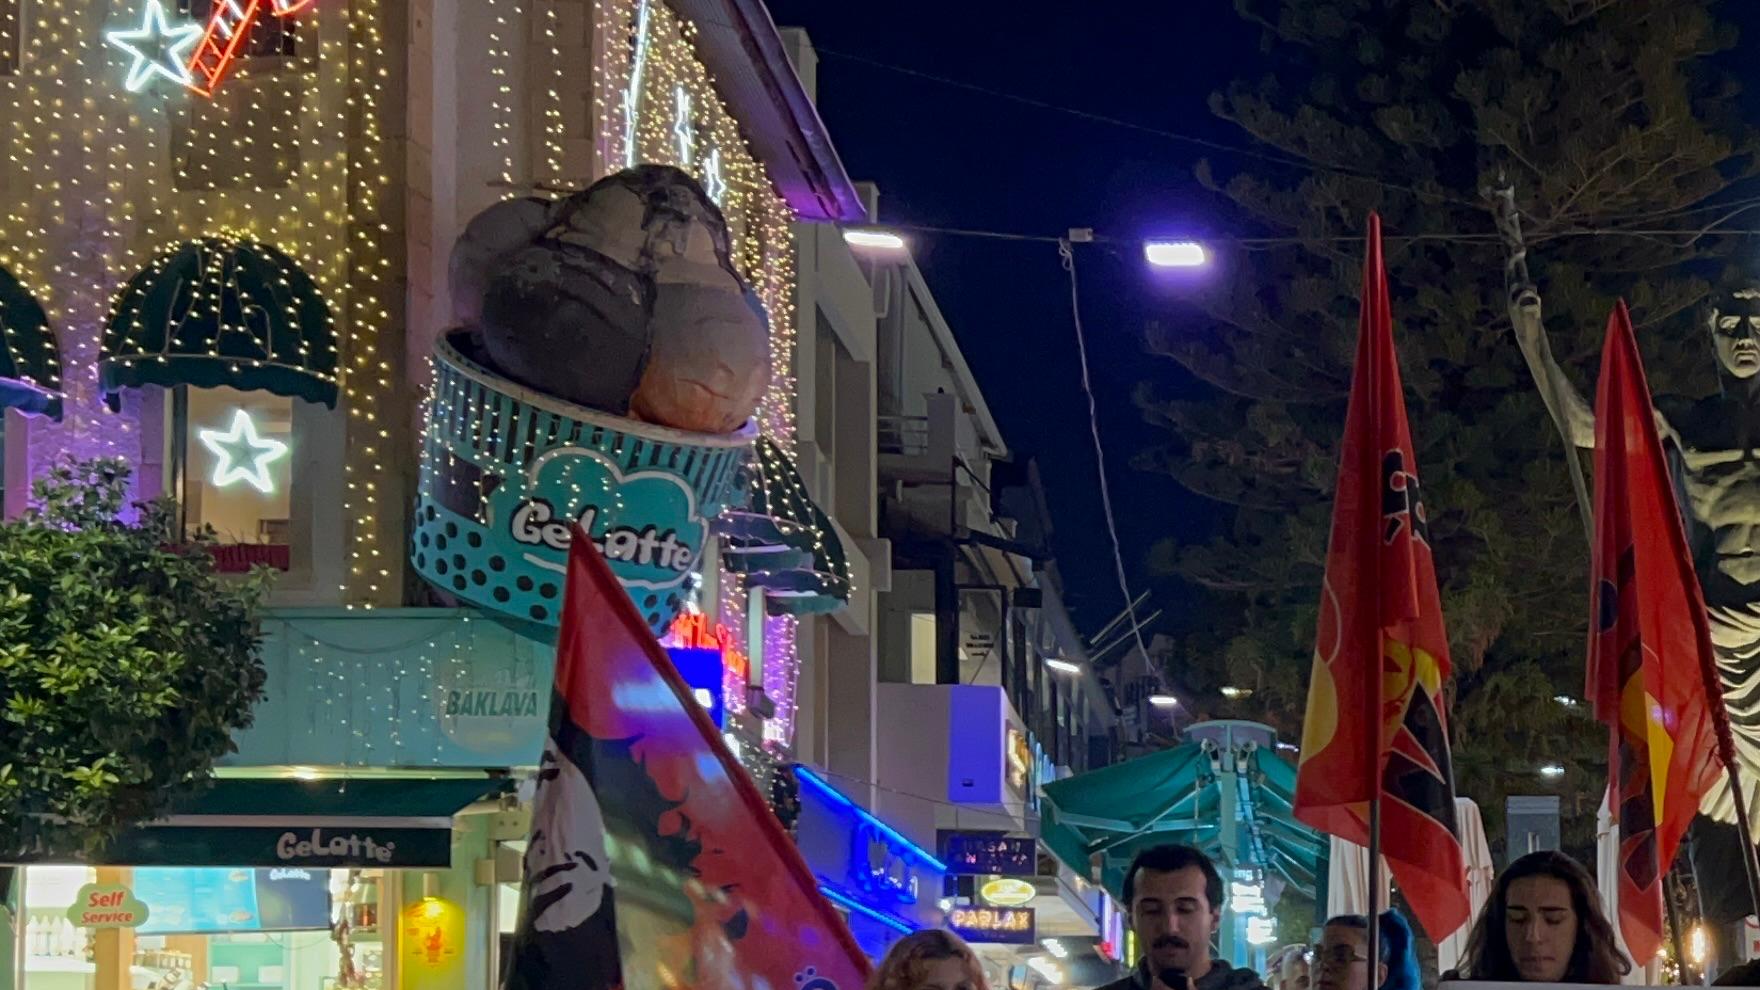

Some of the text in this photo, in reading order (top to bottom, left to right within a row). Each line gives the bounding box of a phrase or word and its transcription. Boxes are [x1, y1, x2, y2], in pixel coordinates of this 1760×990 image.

[446, 690, 538, 717] BAKLAVA
[88, 891, 125, 909] Self
[81, 909, 134, 925] Service
